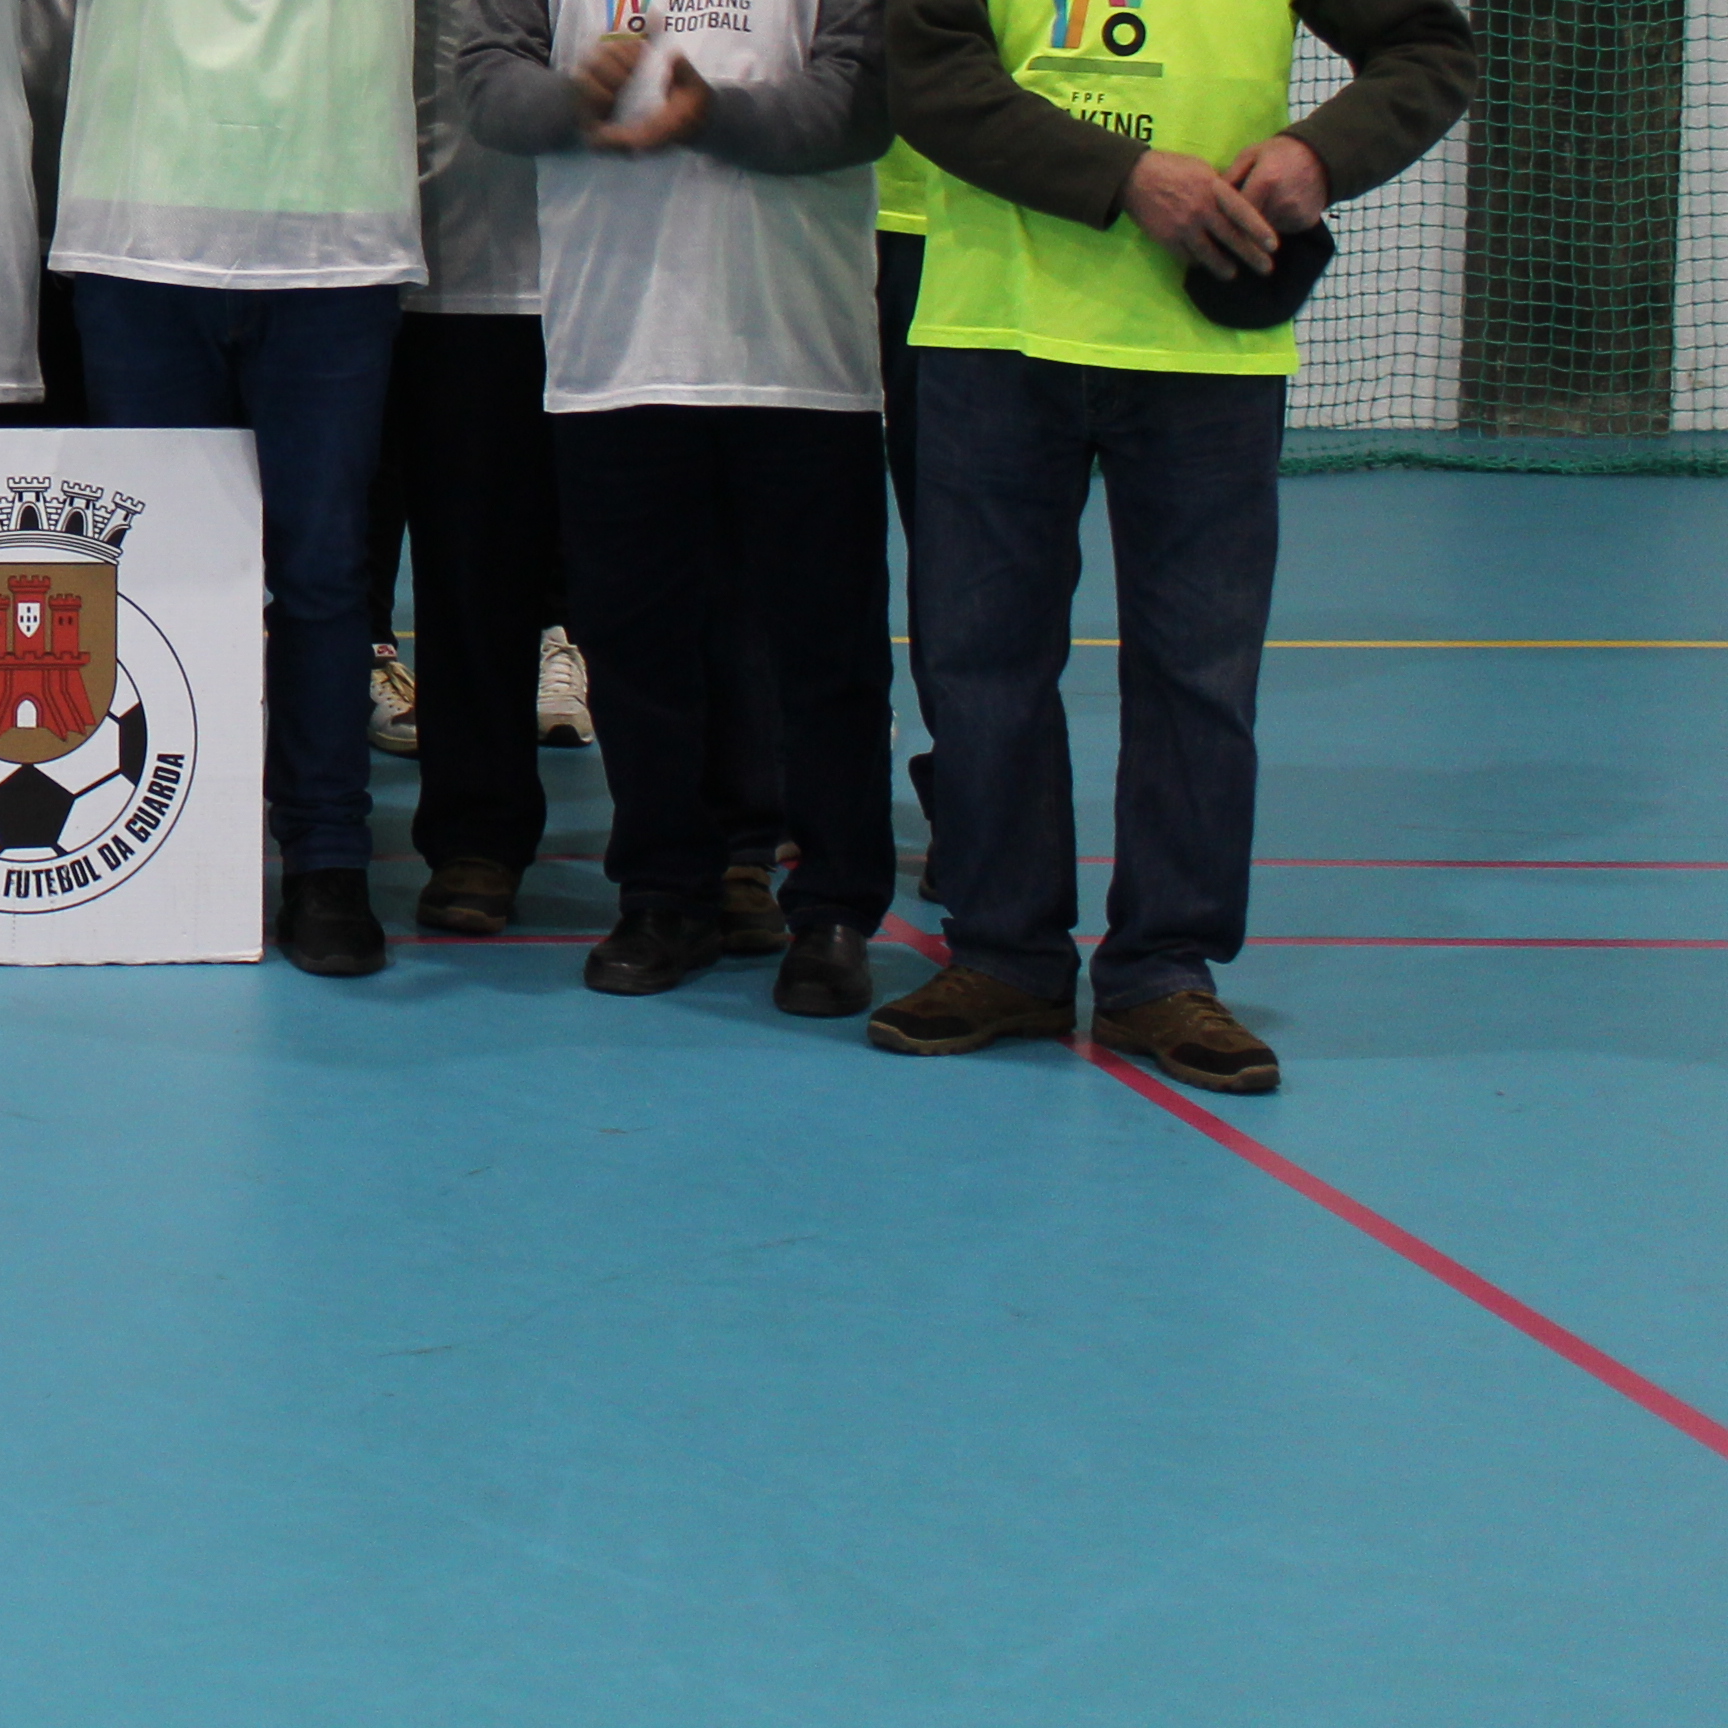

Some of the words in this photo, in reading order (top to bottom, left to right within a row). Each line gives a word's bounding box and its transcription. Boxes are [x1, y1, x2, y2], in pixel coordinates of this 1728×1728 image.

[664, 12, 752, 33] FOOTBALL
[3, 856, 103, 898] FUTEBOL
[96, 834, 135, 871] DA
[125, 753, 185, 844] GUARDA
